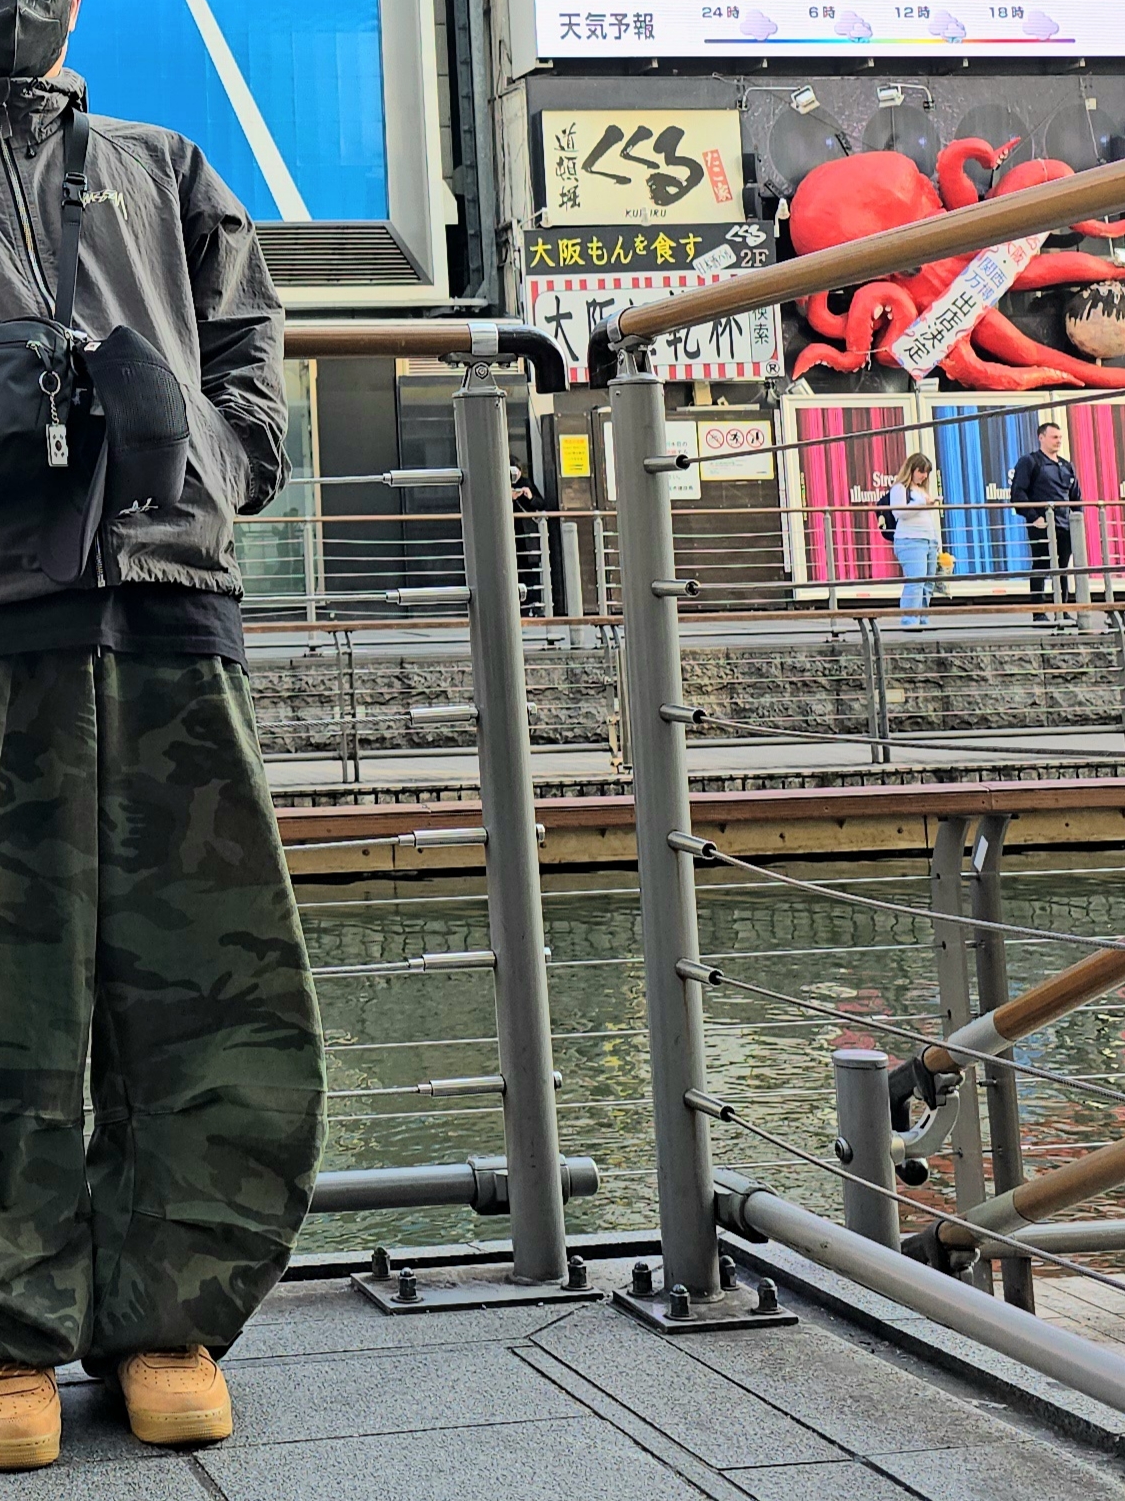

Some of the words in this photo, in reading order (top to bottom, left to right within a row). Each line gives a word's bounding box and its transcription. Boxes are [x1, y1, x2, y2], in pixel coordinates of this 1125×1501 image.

[558, 11, 655, 40] 天気予報
[554, 121, 581, 213] 道頓堀
[581, 124, 705, 206] くくる
[529, 231, 703, 268] 大阪もんを食す
[740, 248, 770, 268] 2F
[965, 270, 995, 301] 万博
[977, 256, 1008, 289] 関西
[903, 291, 977, 365] 出店決定
